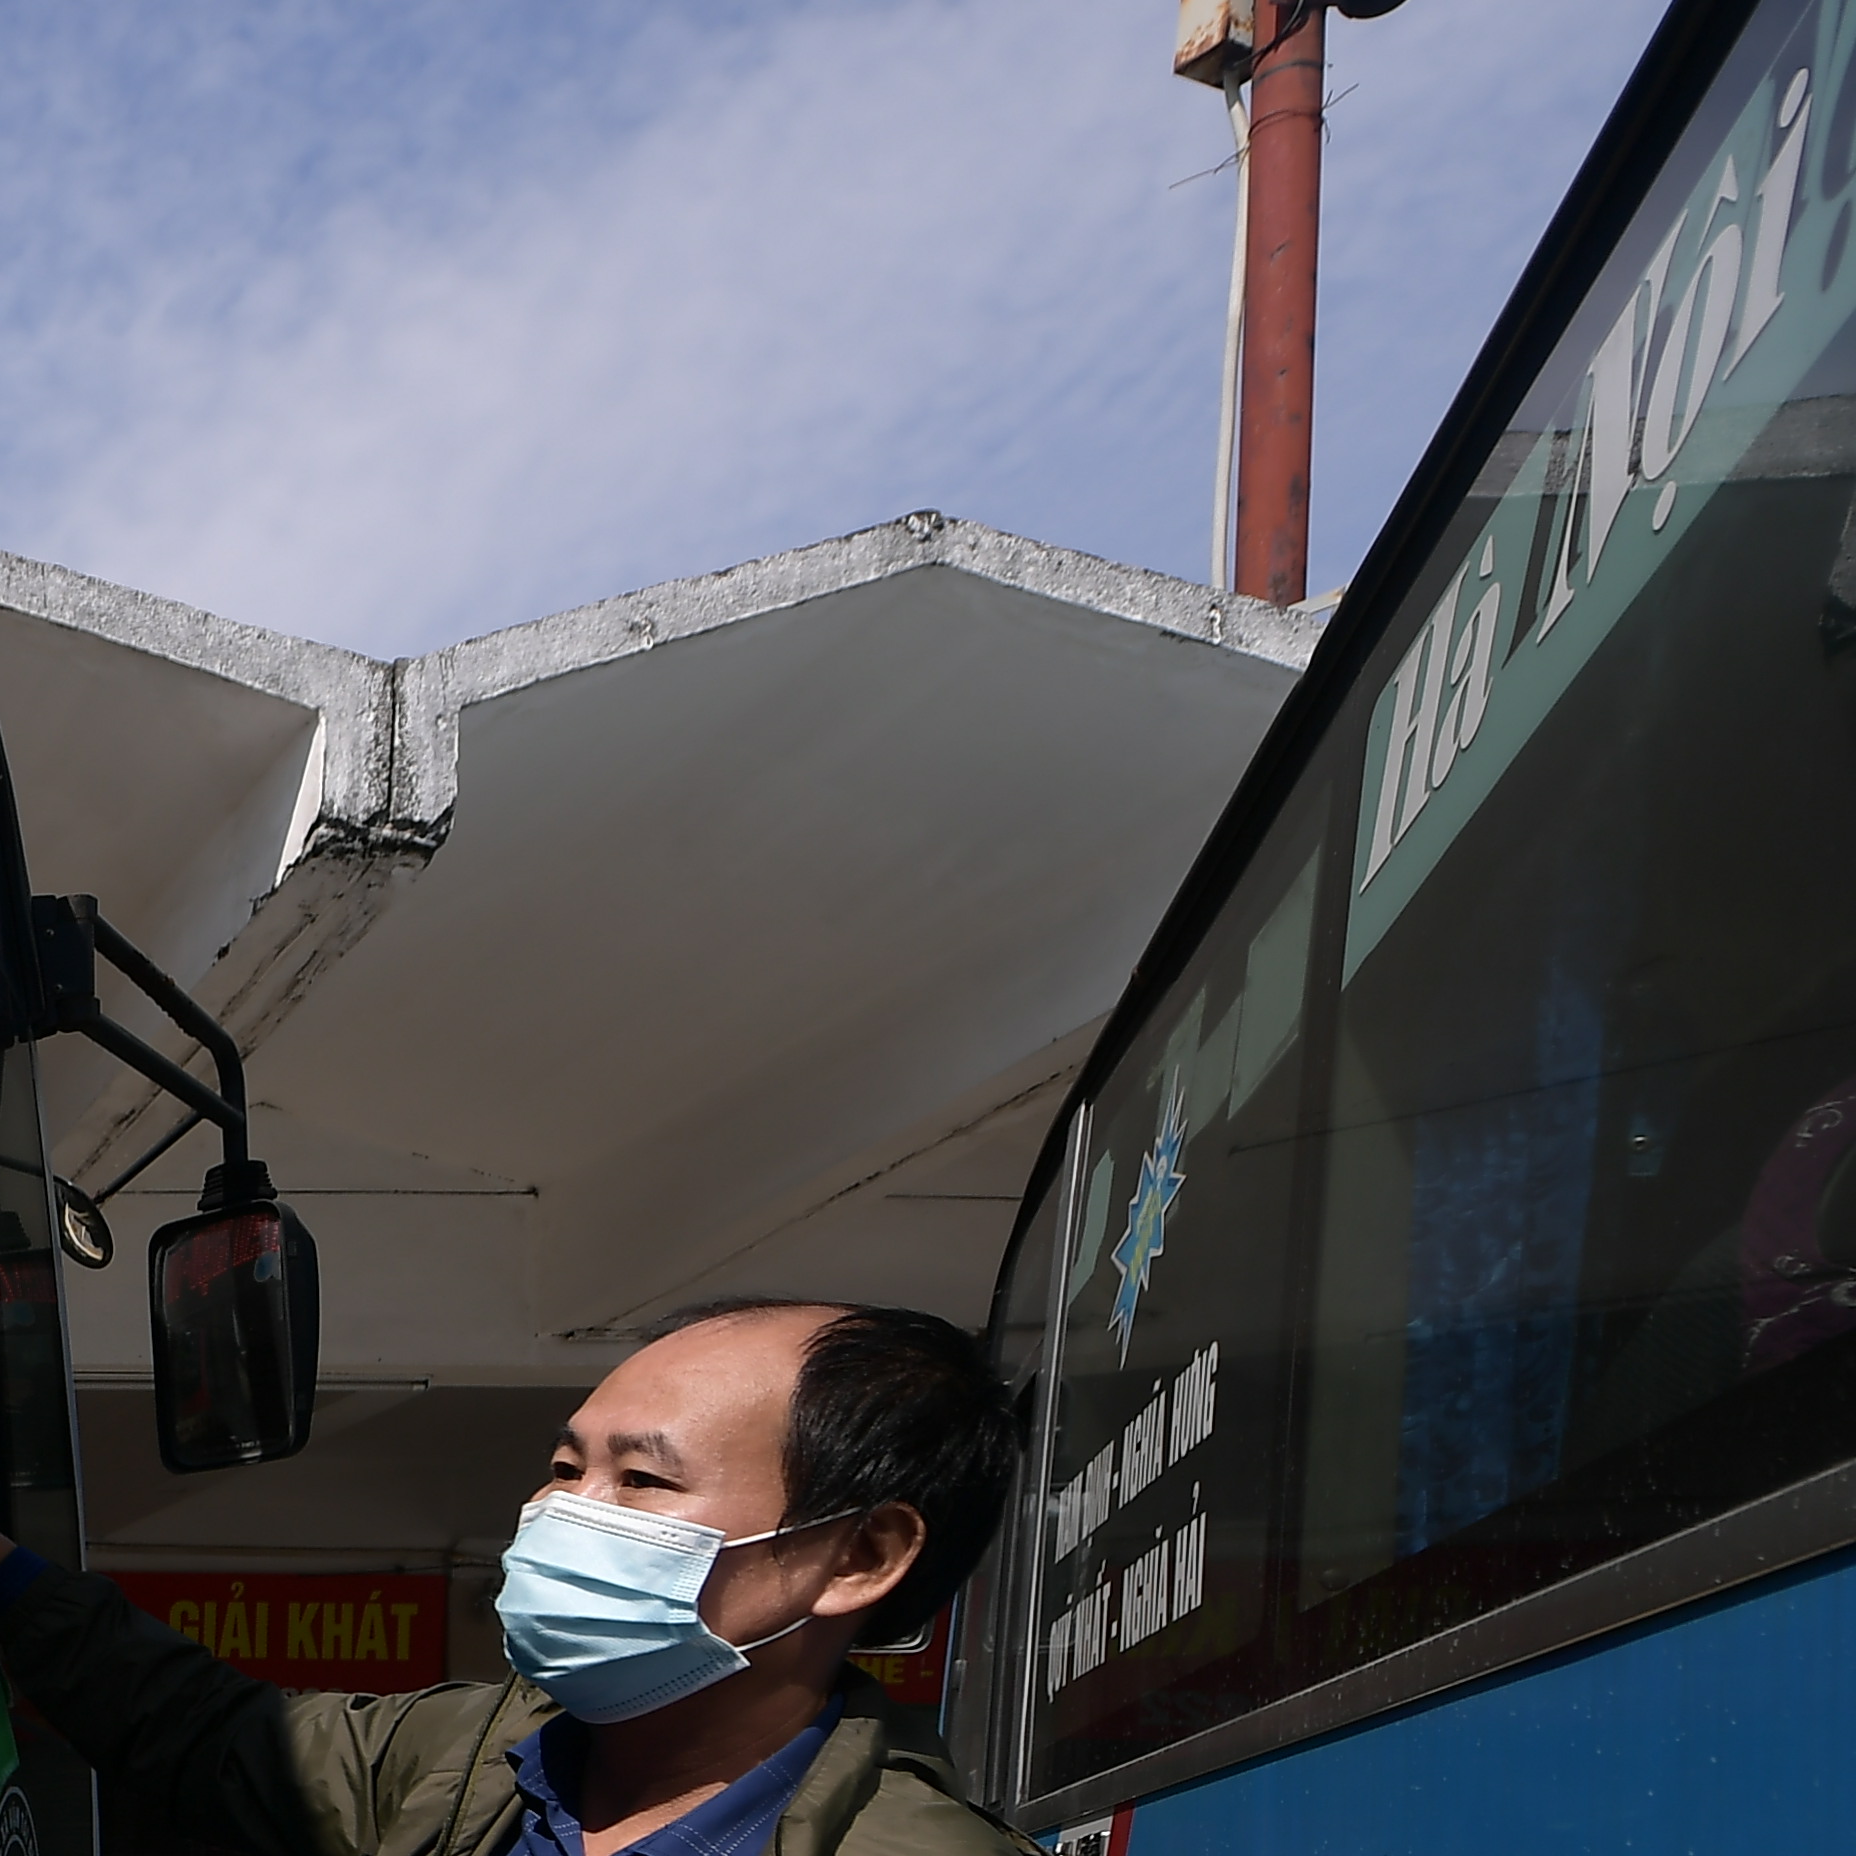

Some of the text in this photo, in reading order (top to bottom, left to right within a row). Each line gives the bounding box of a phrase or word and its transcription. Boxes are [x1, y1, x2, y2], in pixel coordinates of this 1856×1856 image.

[1360, 67, 1812, 896] Hà Nội
[169, 1580, 419, 1661] GIẢI KHÁT
[1171, 1480, 1207, 1623] HẢI
